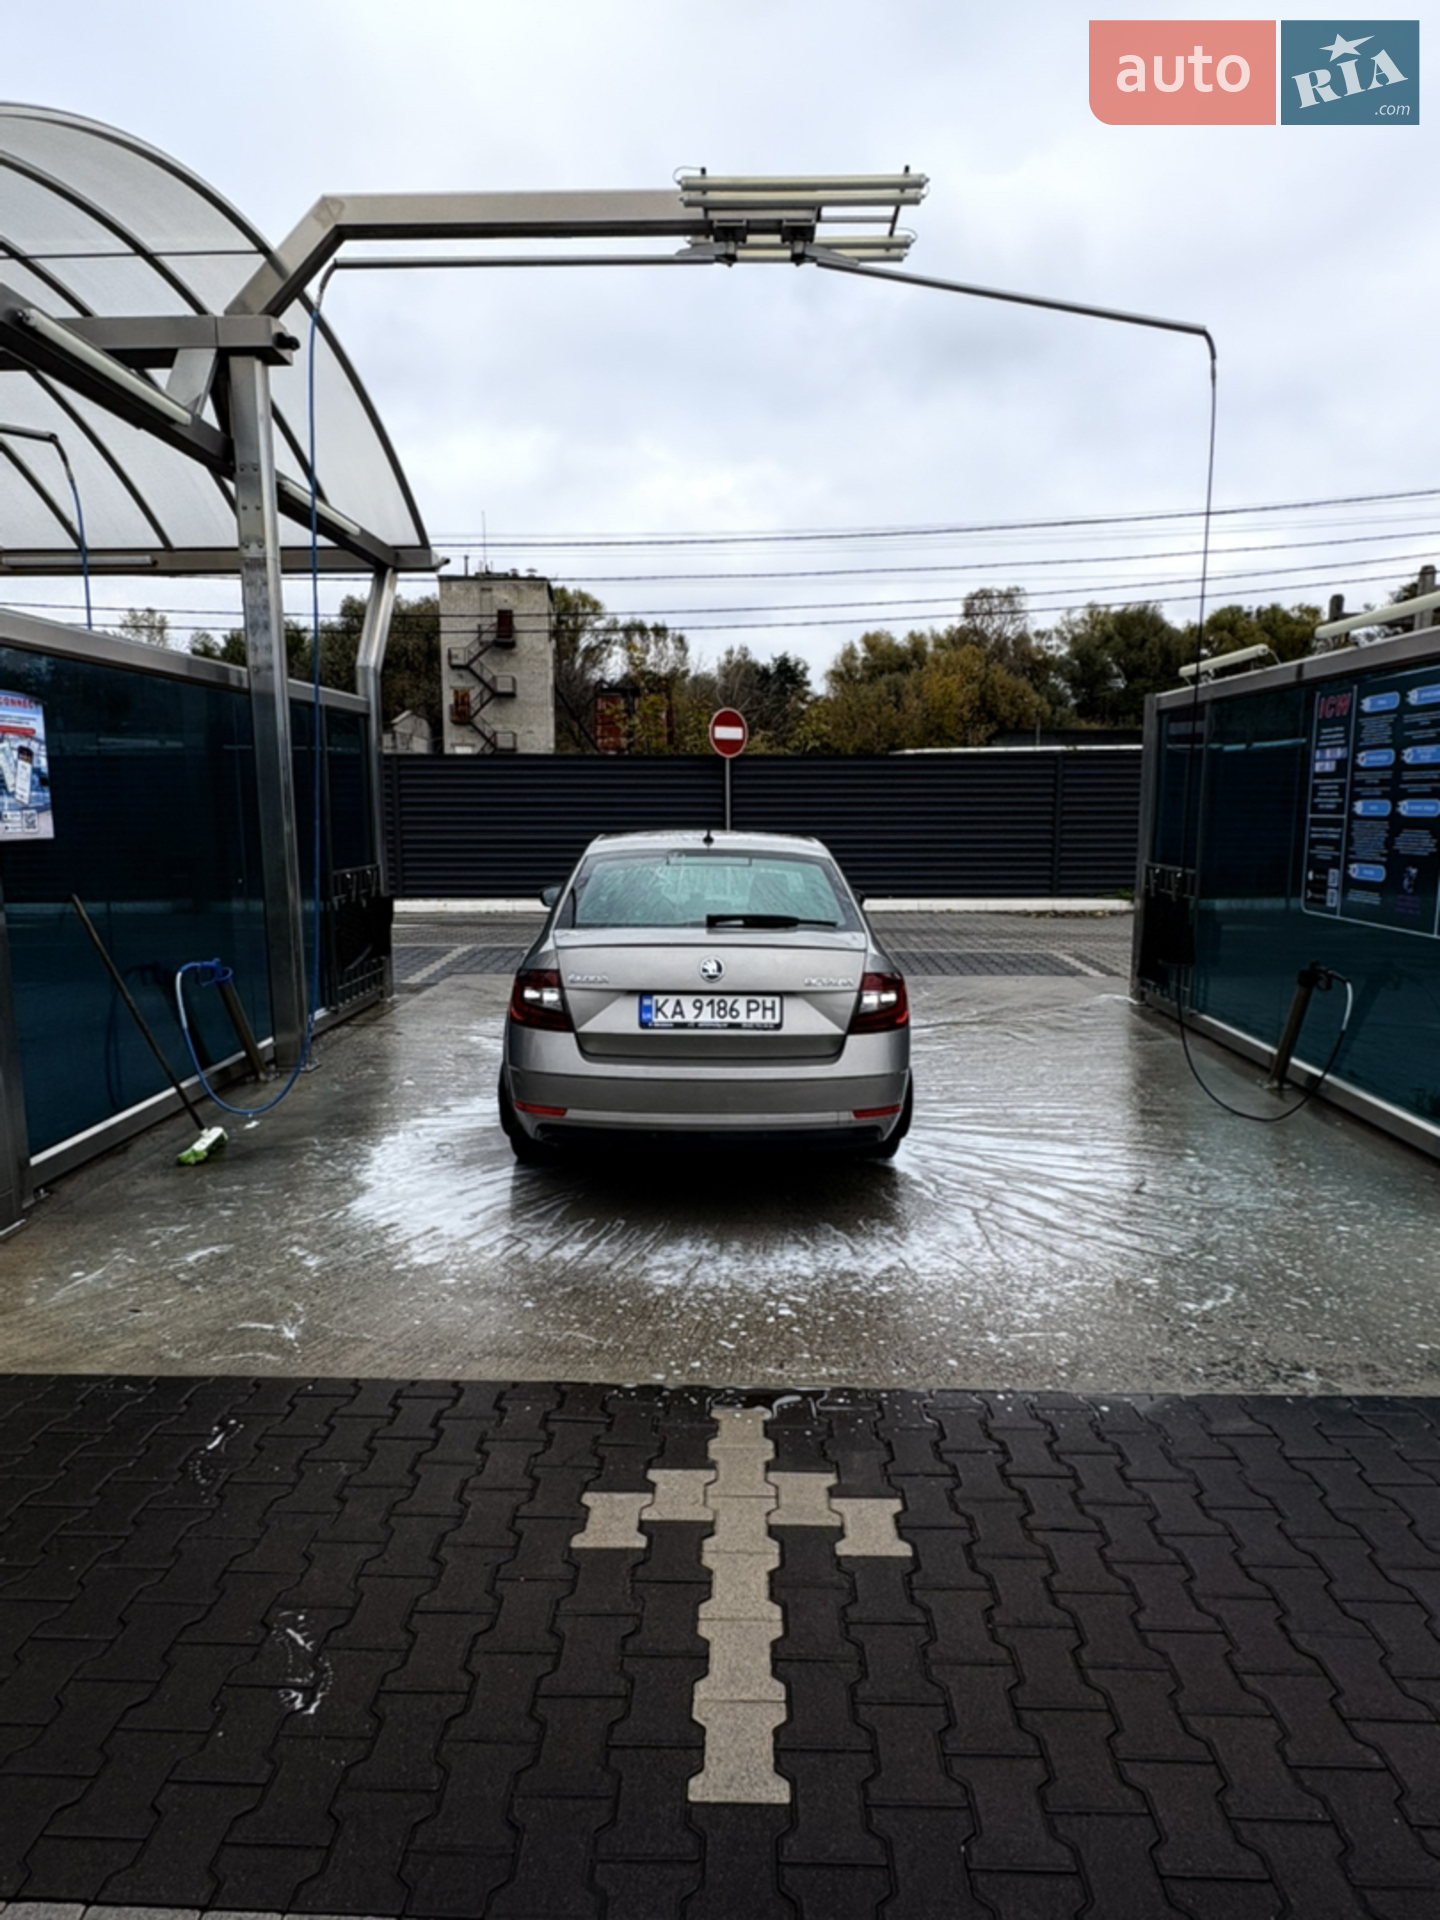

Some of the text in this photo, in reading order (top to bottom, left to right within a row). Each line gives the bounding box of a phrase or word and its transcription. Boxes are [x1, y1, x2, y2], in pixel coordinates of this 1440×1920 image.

[654, 998, 777, 1019] KA 9186 PH
